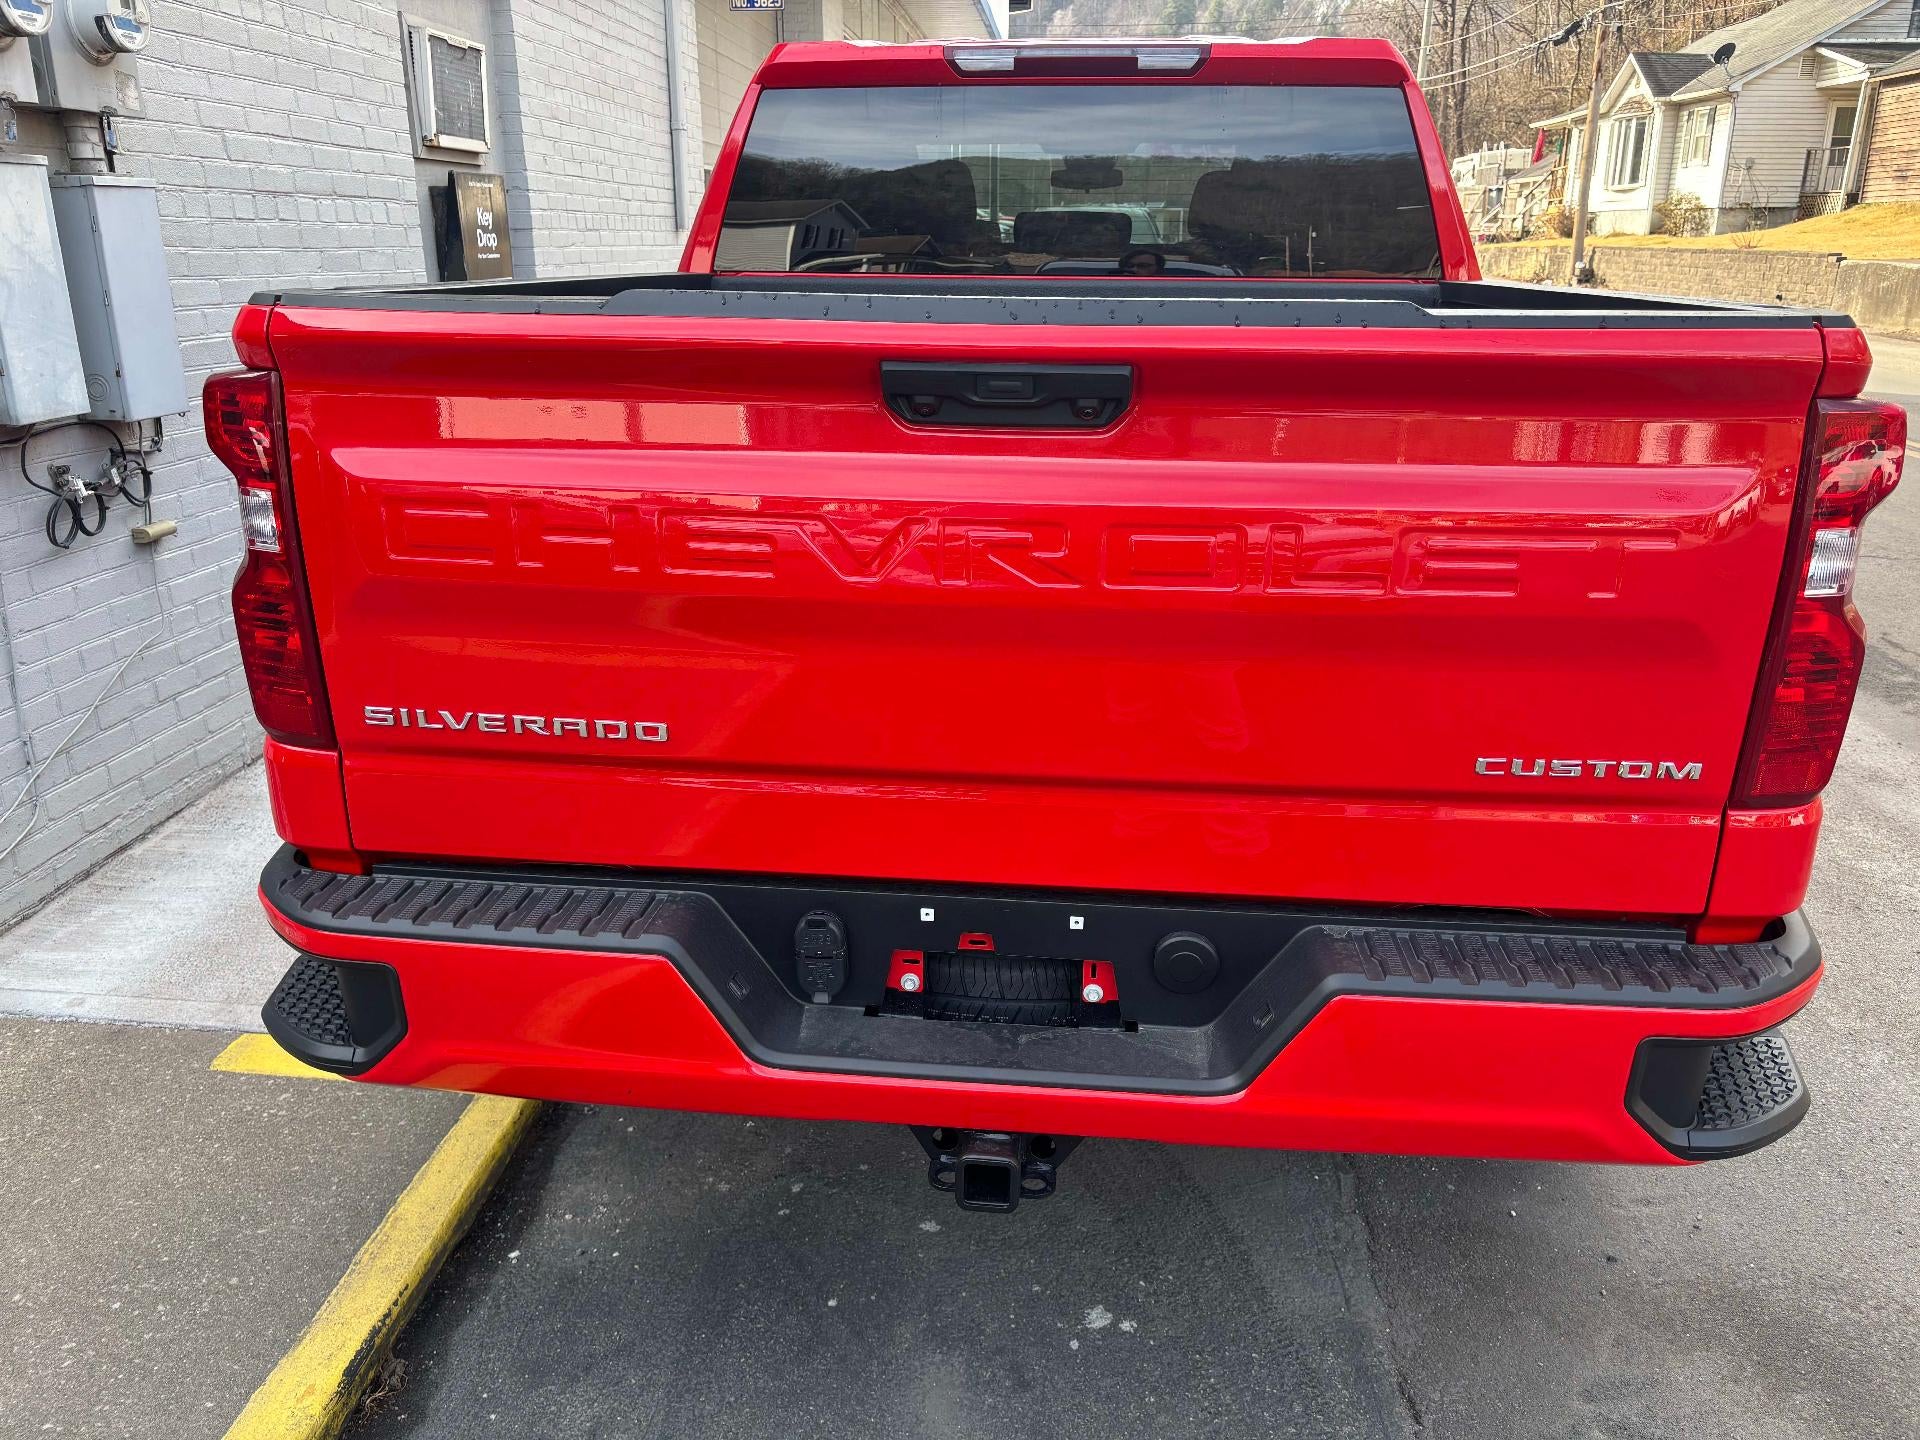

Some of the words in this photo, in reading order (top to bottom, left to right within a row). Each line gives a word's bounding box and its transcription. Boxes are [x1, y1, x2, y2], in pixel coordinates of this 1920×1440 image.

[476, 207, 493, 230] Key
[476, 228, 498, 251] Drop
[383, 498, 1683, 601] CHEVROLET
[364, 705, 669, 742] SILVERADO
[1475, 757, 1703, 780] CUSTOM
